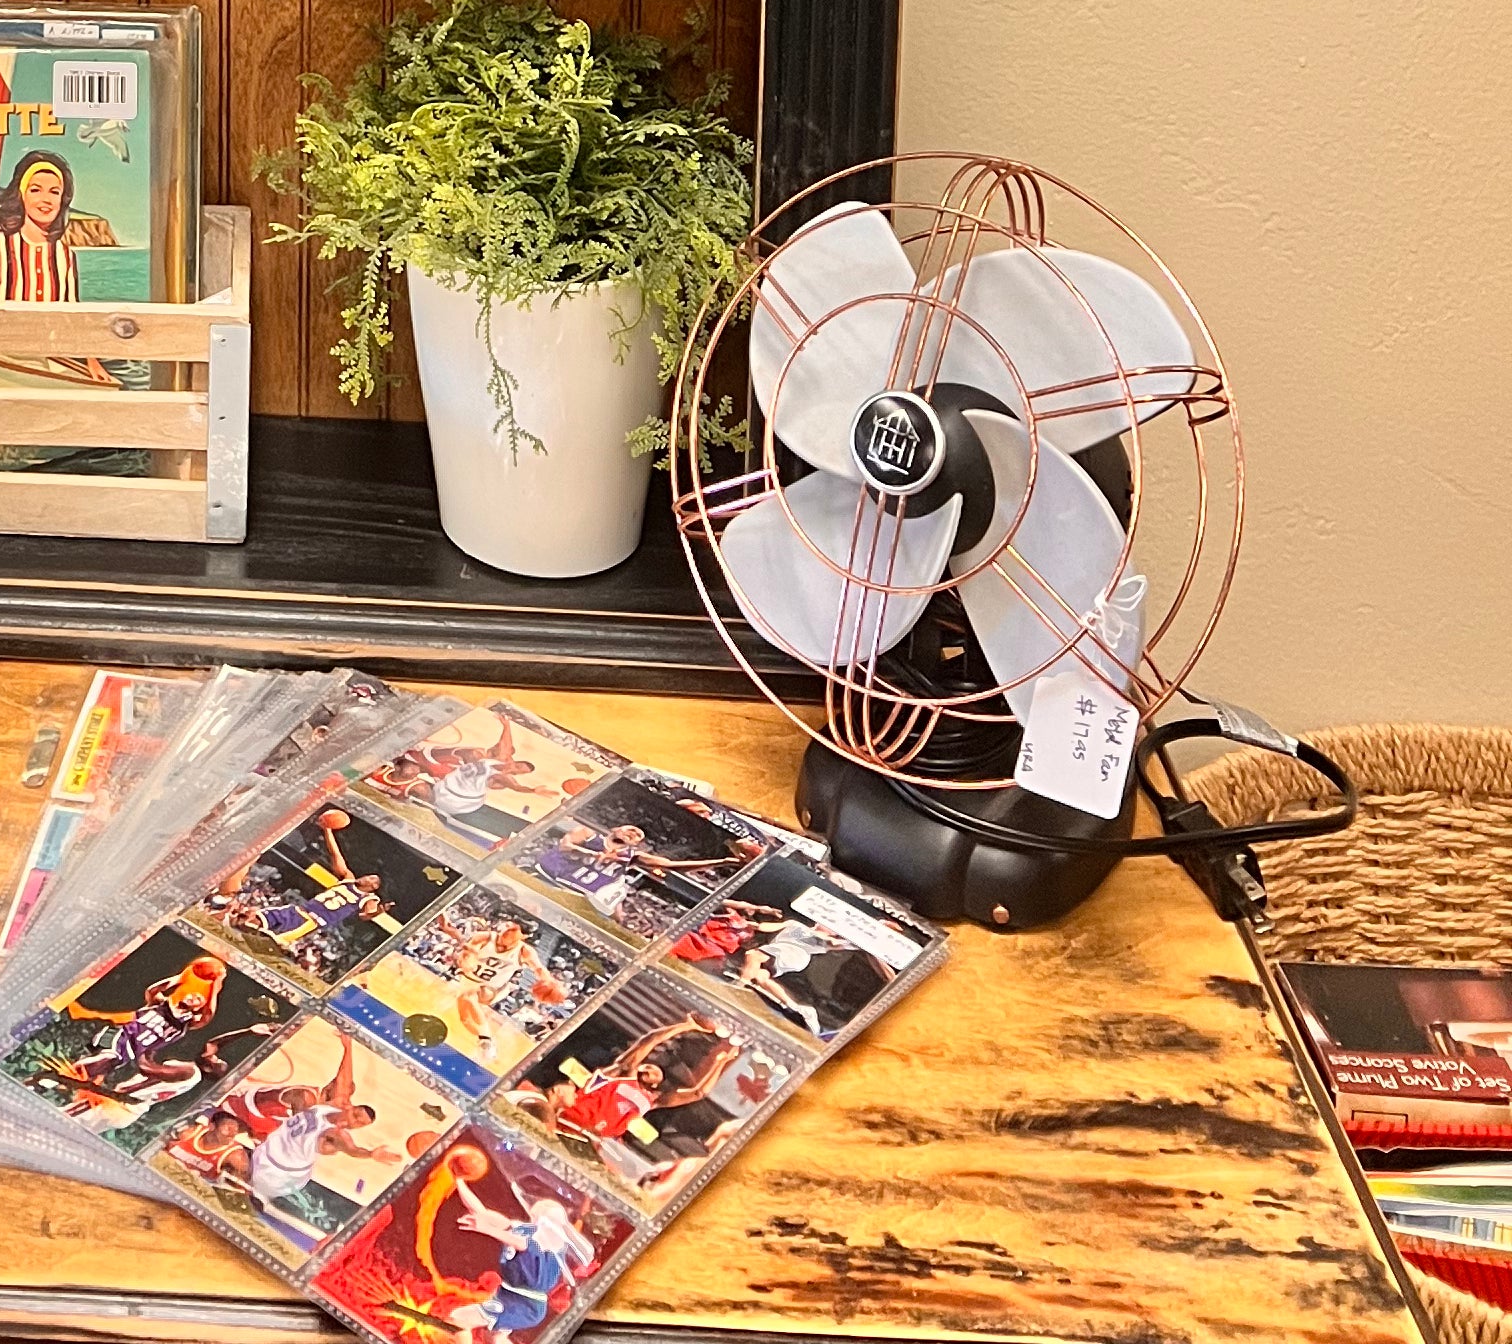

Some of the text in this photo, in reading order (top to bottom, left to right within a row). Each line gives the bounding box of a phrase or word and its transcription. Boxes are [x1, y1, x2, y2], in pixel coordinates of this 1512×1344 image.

[1328, 1054, 1478, 1076] Votive Sconces
[1336, 1070, 1512, 1092] Set of Two Plume
